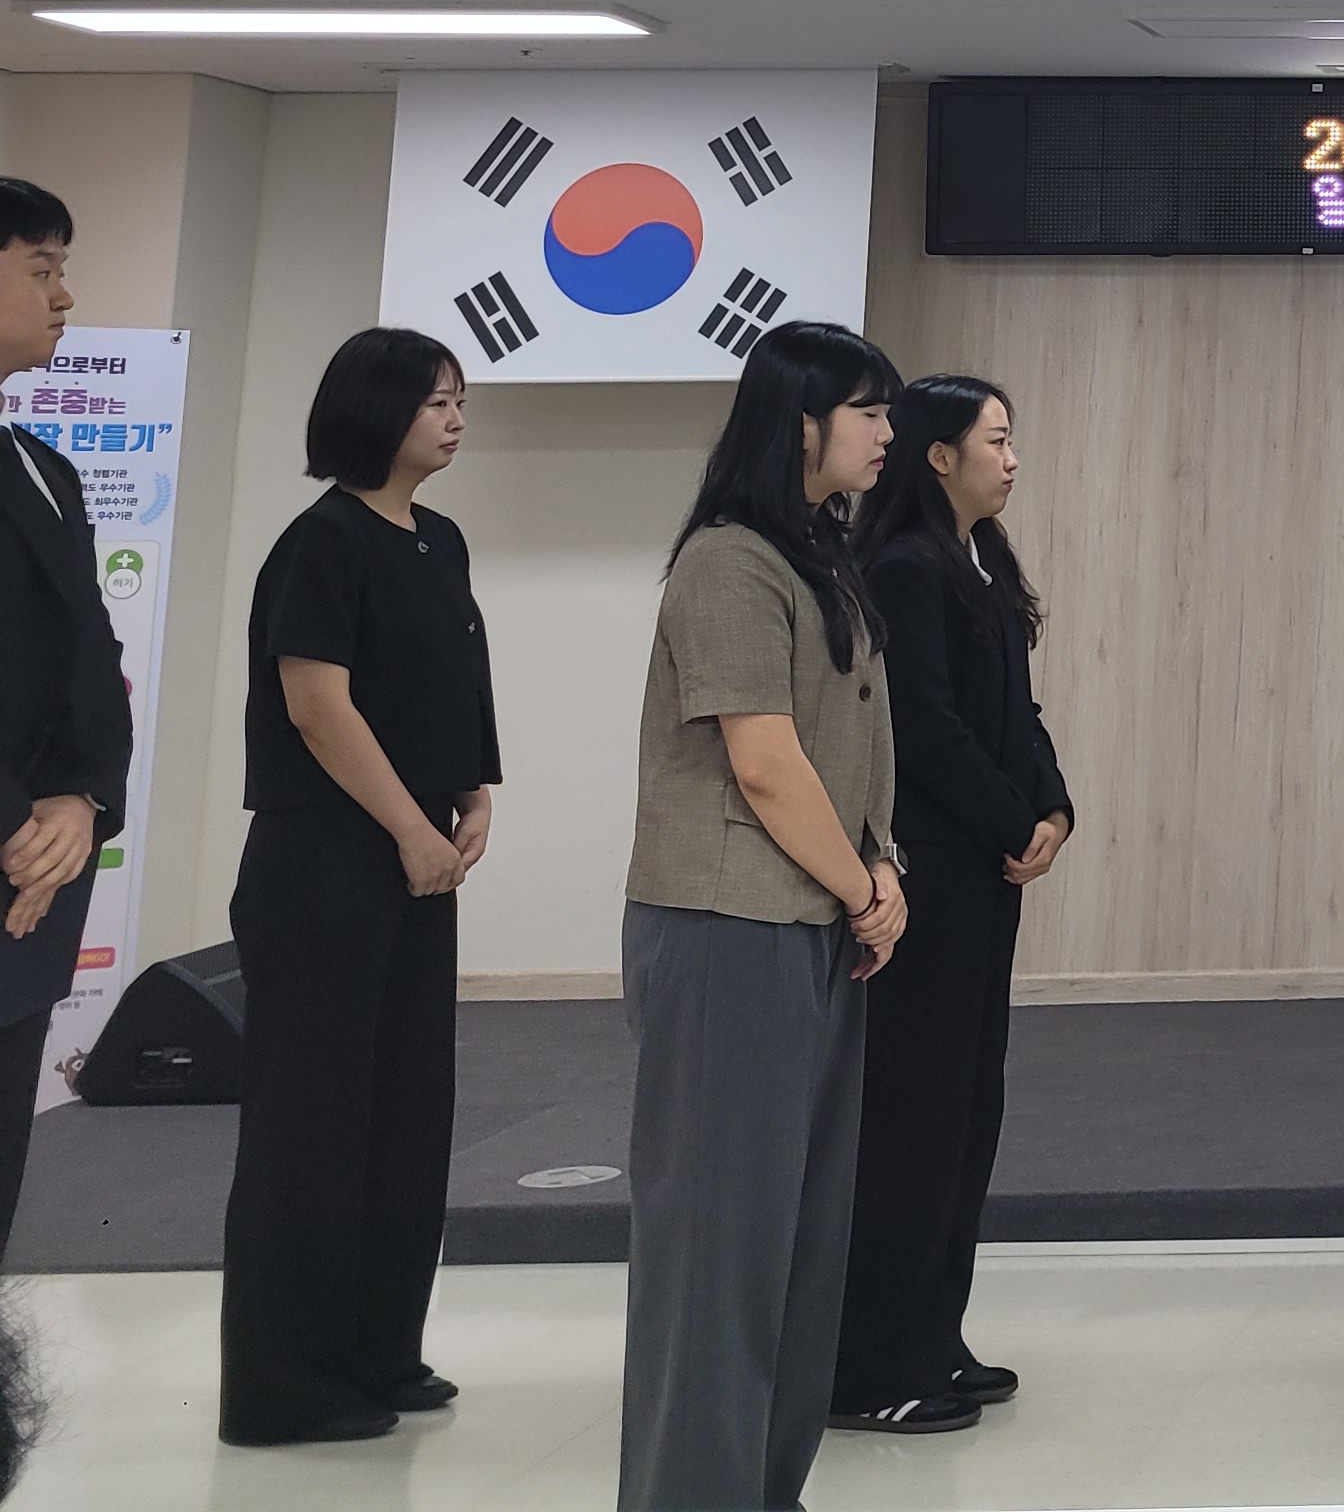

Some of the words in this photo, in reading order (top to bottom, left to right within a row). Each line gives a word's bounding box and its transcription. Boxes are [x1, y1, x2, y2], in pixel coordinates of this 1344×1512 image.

[31, 388, 126, 415] 존중받는
[17, 422, 63, 451] 장
[99, 483, 136, 493] 우수기관
[97, 511, 134, 521] 우수기관
